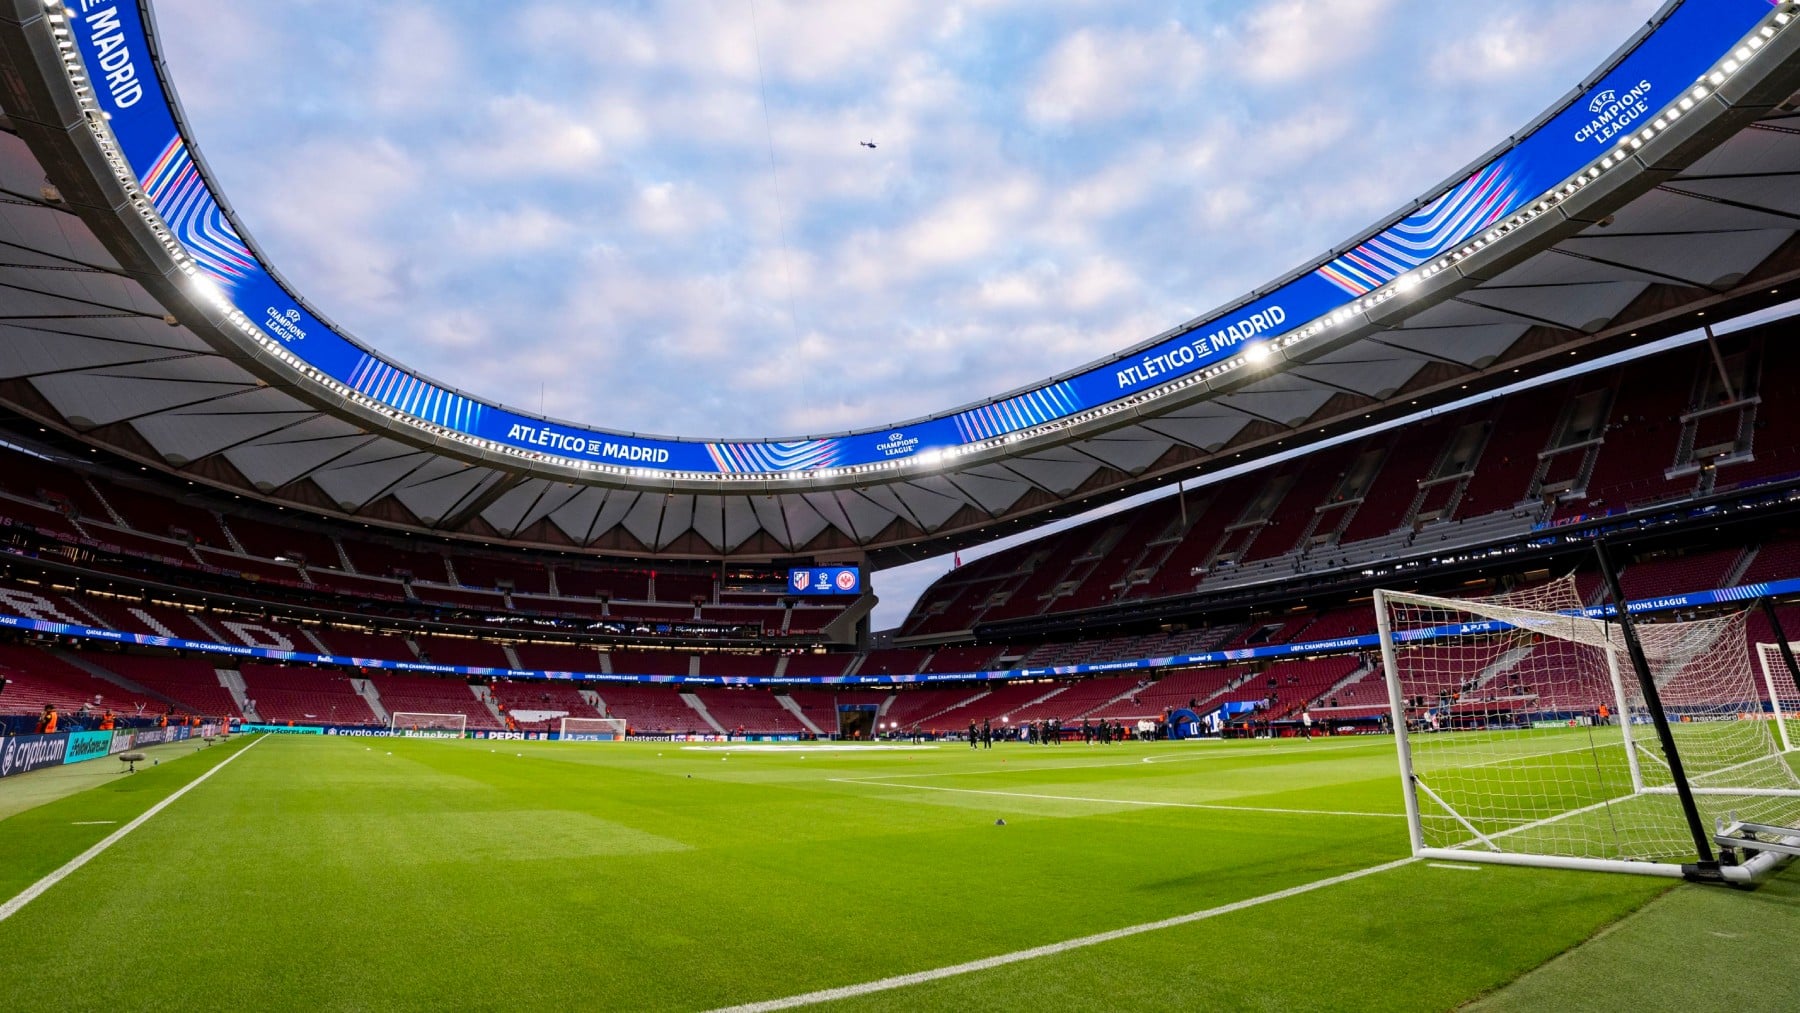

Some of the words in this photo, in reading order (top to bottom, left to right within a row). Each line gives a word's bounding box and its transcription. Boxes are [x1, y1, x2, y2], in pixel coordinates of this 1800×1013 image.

[86, 6, 143, 109] MADRID
[1574, 79, 1652, 142] CHAMPIONS
[1591, 92, 1615, 113] UEFA
[1594, 100, 1649, 144] LEAGUE
[265, 318, 294, 342] LEAGUE
[266, 306, 307, 340] CHAMPIONS
[1116, 346, 1195, 389] ATLÉTICO
[1196, 342, 1210, 354] DE
[1209, 305, 1286, 352] MADRID
[507, 423, 586, 453] ATLÉTICO
[588, 443, 600, 453] DE
[602, 442, 669, 463] MADRID
[876, 437, 919, 451] CHAMPIONS
[885, 445, 914, 456] LEAGUE
[1604, 601, 1653, 616] CHPIONS
[1654, 596, 1688, 608] LEAGUE
[86, 628, 102, 636] QATAR
[185, 641, 199, 649] UEFA
[200, 643, 231, 652] CHAMPIONS
[1305, 642, 1337, 650] CHAMPIONS
[1336, 639, 1359, 647] LEAGUE
[488, 731, 525, 741] PEPSI
[15, 735, 65, 772] crypto.com
